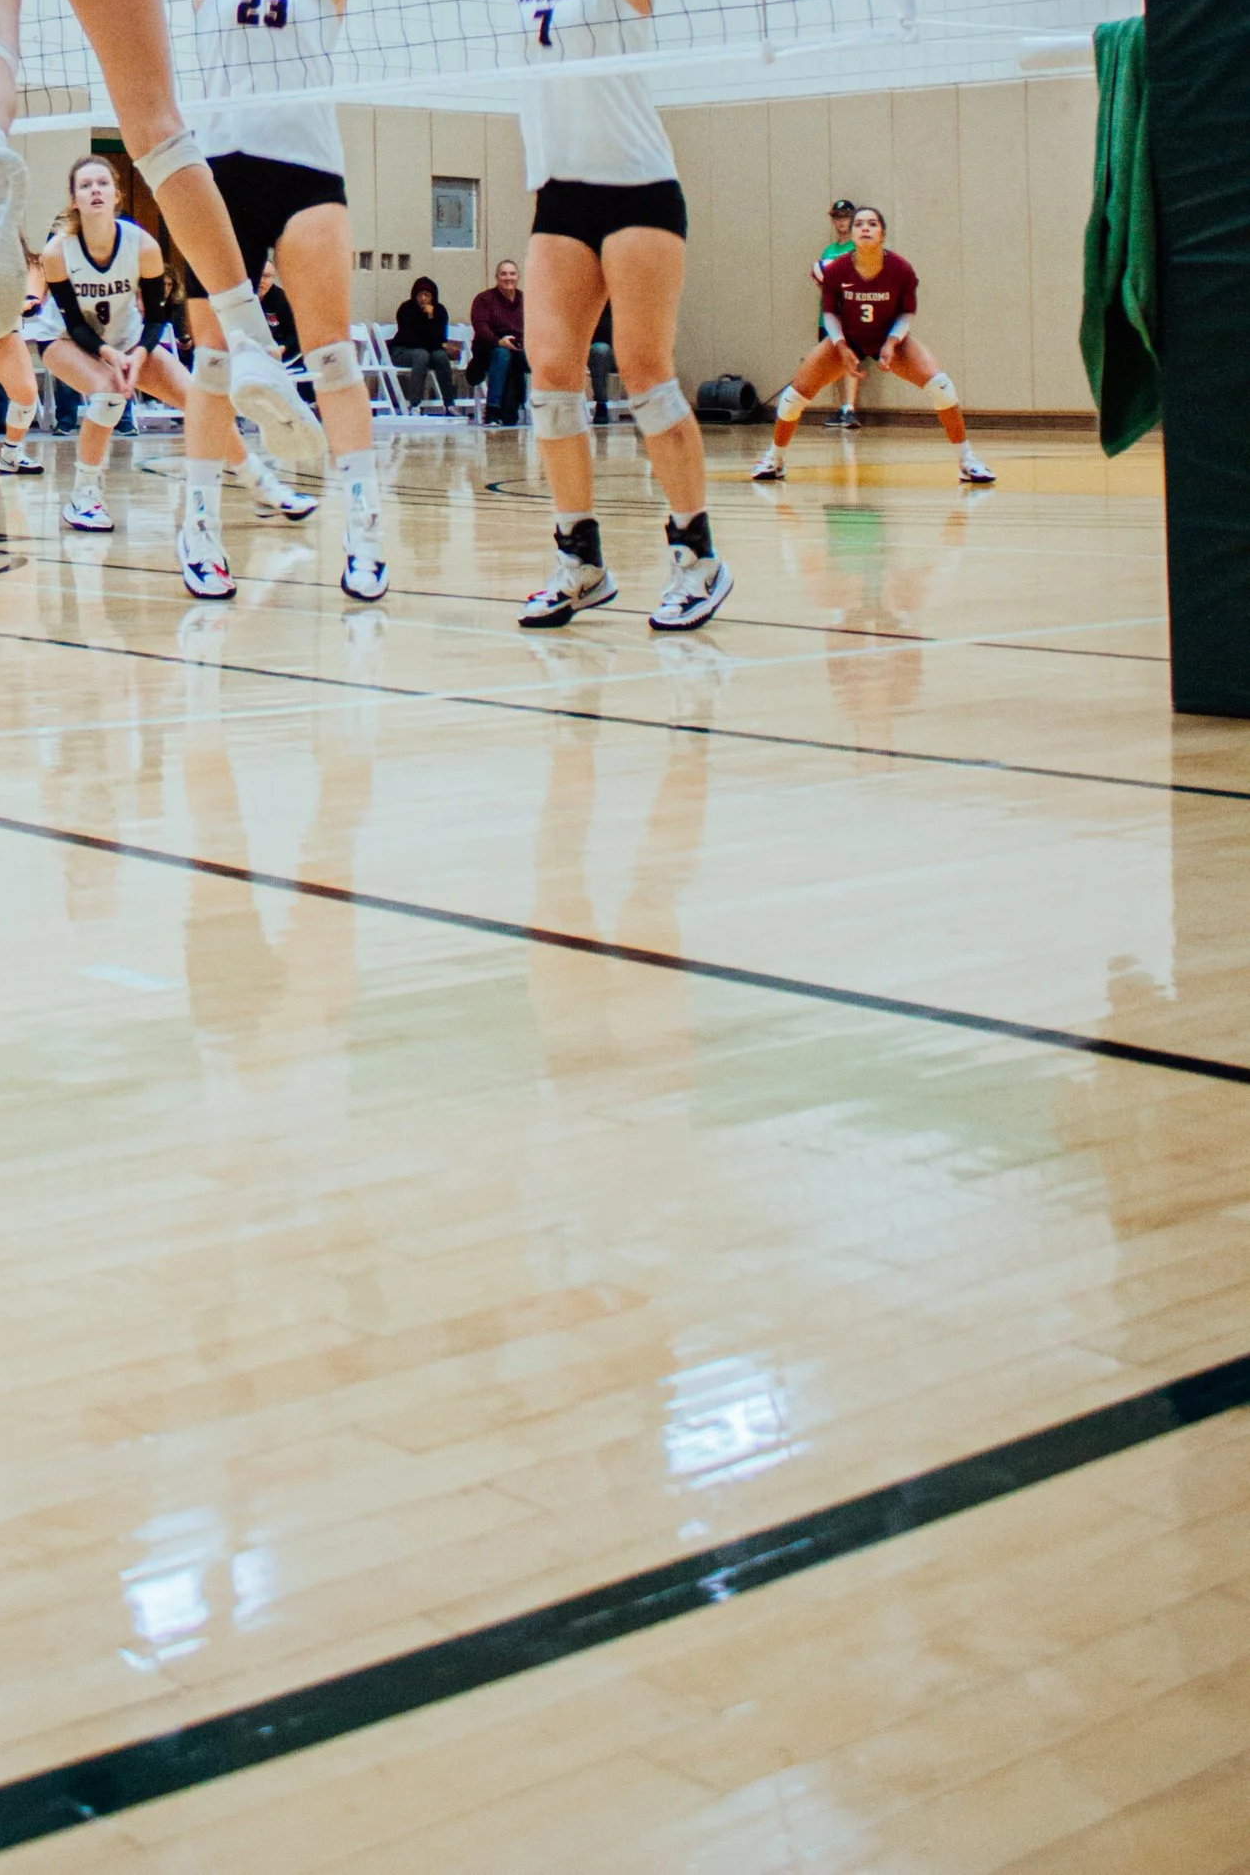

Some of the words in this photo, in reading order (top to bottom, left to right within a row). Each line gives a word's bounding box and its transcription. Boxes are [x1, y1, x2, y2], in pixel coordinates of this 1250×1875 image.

[533, 7, 554, 47] 7
[73, 279, 132, 298] COUGARS
[859, 303, 874, 323] 3
